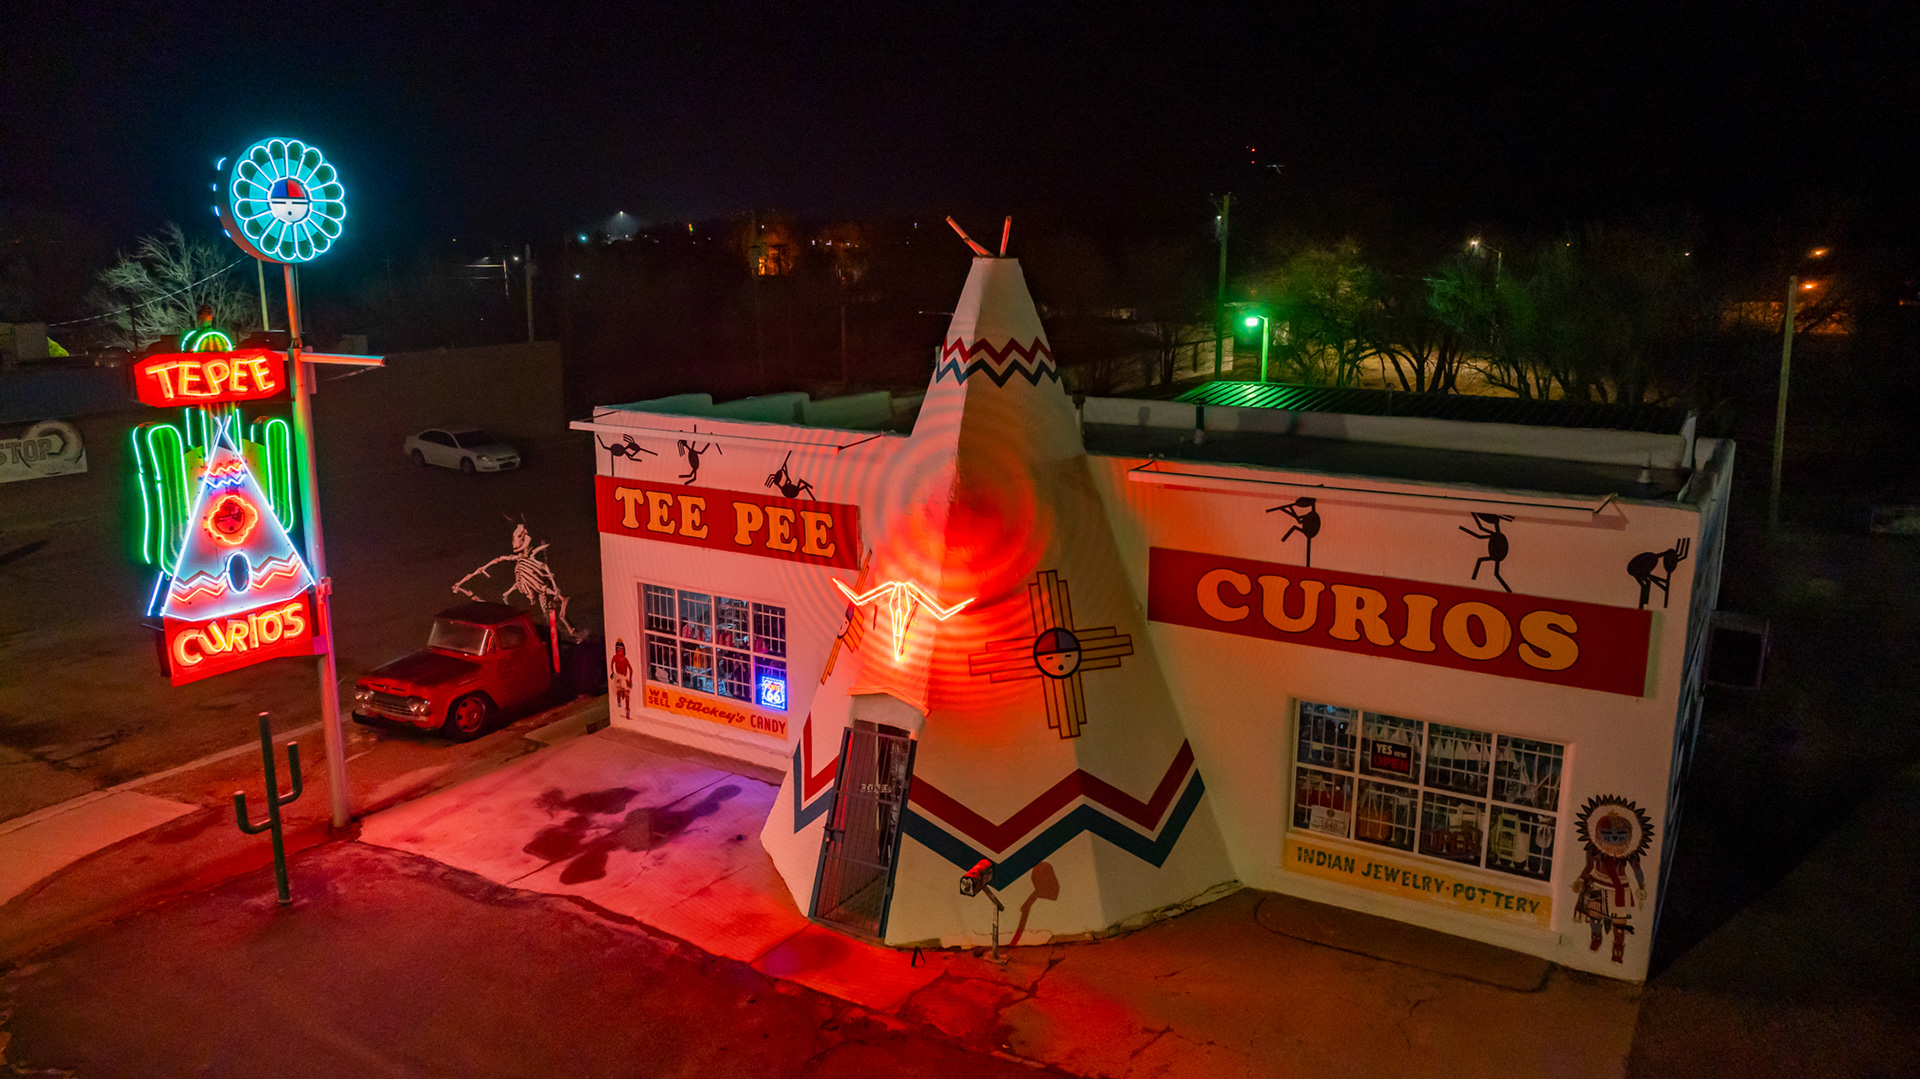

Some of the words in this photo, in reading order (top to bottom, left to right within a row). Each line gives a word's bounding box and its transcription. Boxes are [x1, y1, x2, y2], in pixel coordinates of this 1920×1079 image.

[145, 355, 275, 399] TEPEE
[614, 486, 709, 540] TEE
[732, 501, 836, 559] PEE
[172, 602, 305, 667] CURIOS
[1196, 568, 1580, 671] CURIOS
[648, 696, 671, 708] SELL
[649, 688, 669, 699] WE
[767, 689, 781, 703] 66
[675, 696, 746, 723] Stuckey's
[750, 714, 787, 735] CANDY
[1373, 755, 1409, 773] OPEN
[1375, 743, 1393, 755] YES
[1296, 846, 1356, 874] INDIAN
[1361, 861, 1446, 893] JEWELRY
[1453, 883, 1541, 915] POTTERY
